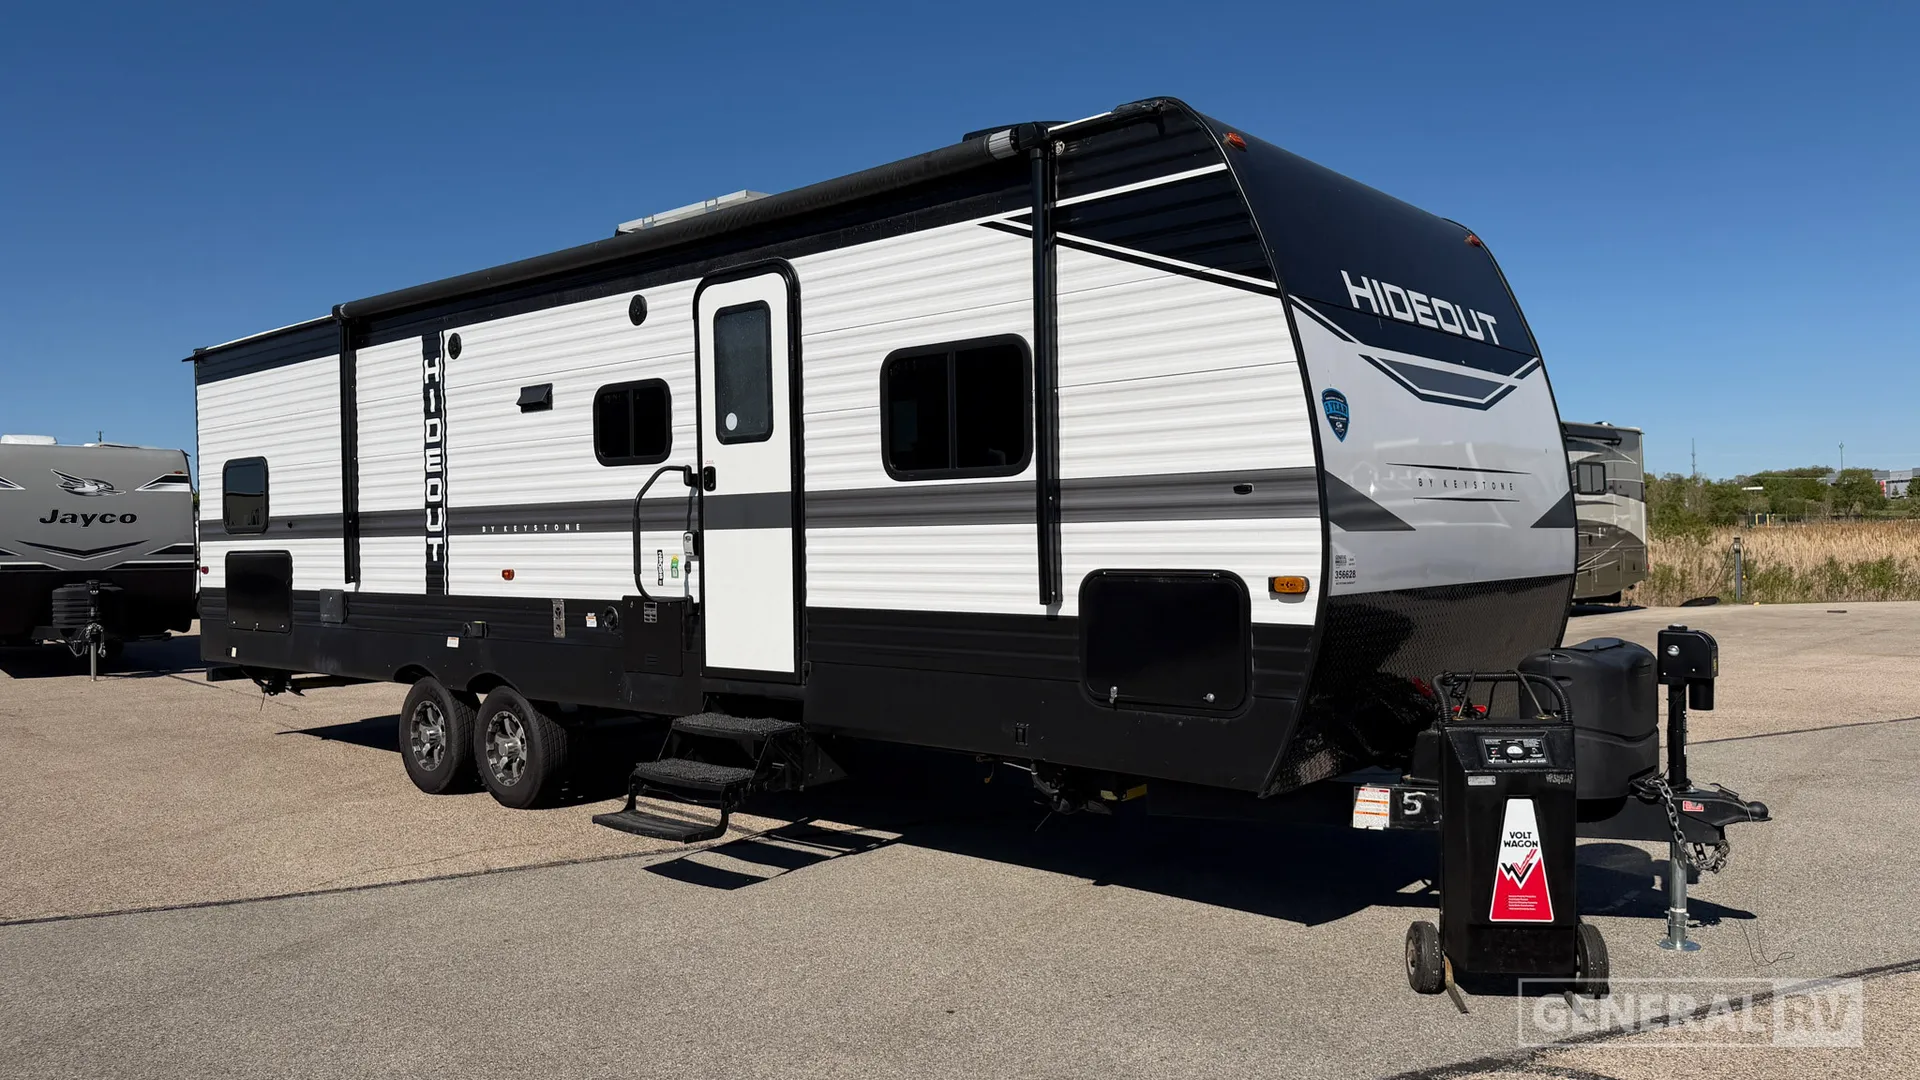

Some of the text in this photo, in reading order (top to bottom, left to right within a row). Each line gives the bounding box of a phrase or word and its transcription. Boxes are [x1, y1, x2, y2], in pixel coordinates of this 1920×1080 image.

[1341, 269, 1500, 345] HIDEOUT
[424, 357, 444, 562] HIDEOUT
[1417, 477, 1515, 492] BY KEYSTONE
[39, 509, 138, 528] Jayco
[482, 523, 581, 533] BY KEYSTONE
[1334, 569, 1357, 580] 356628
[1402, 791, 1427, 815] 5
[1509, 831, 1532, 839] VOLT
[1503, 840, 1539, 848] WAGON
